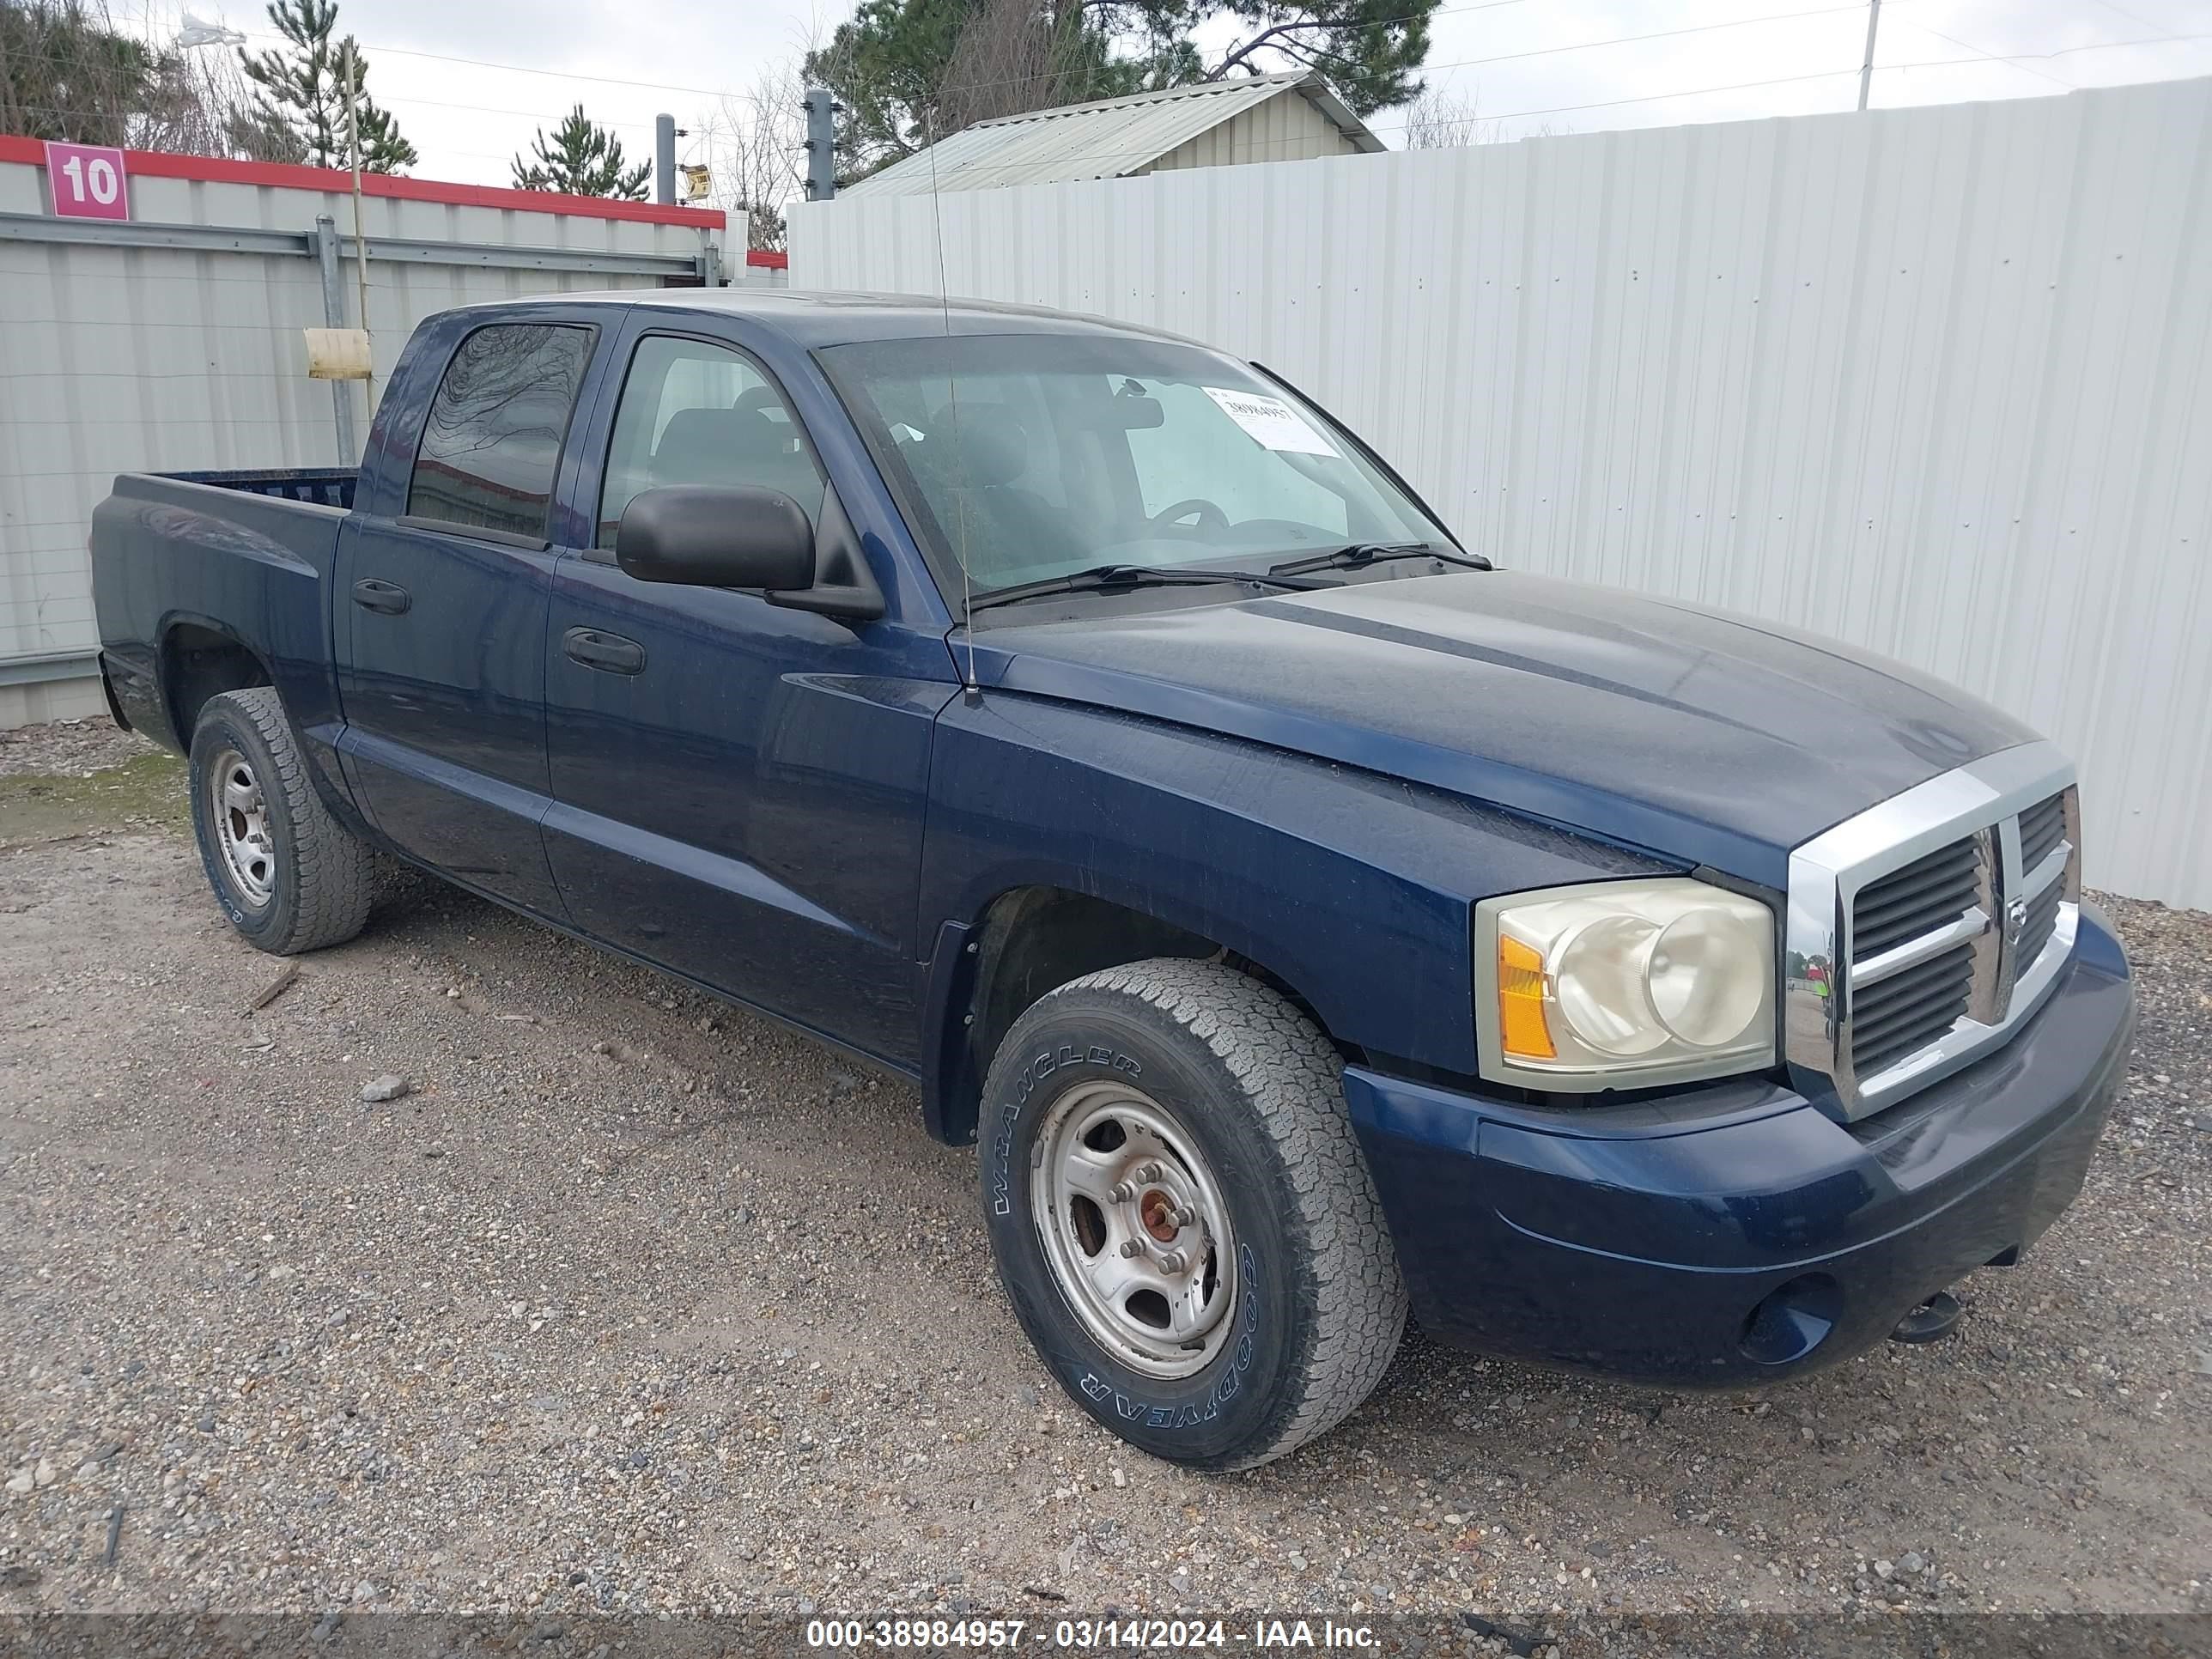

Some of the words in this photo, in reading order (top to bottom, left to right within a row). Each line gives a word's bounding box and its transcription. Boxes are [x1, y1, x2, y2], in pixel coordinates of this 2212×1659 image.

[63, 155, 118, 204] 10
[1224, 401, 1292, 421] 38984957
[993, 1044, 1143, 1215] WRANGLER
[1079, 1243, 1259, 1429] GOODYEAR
